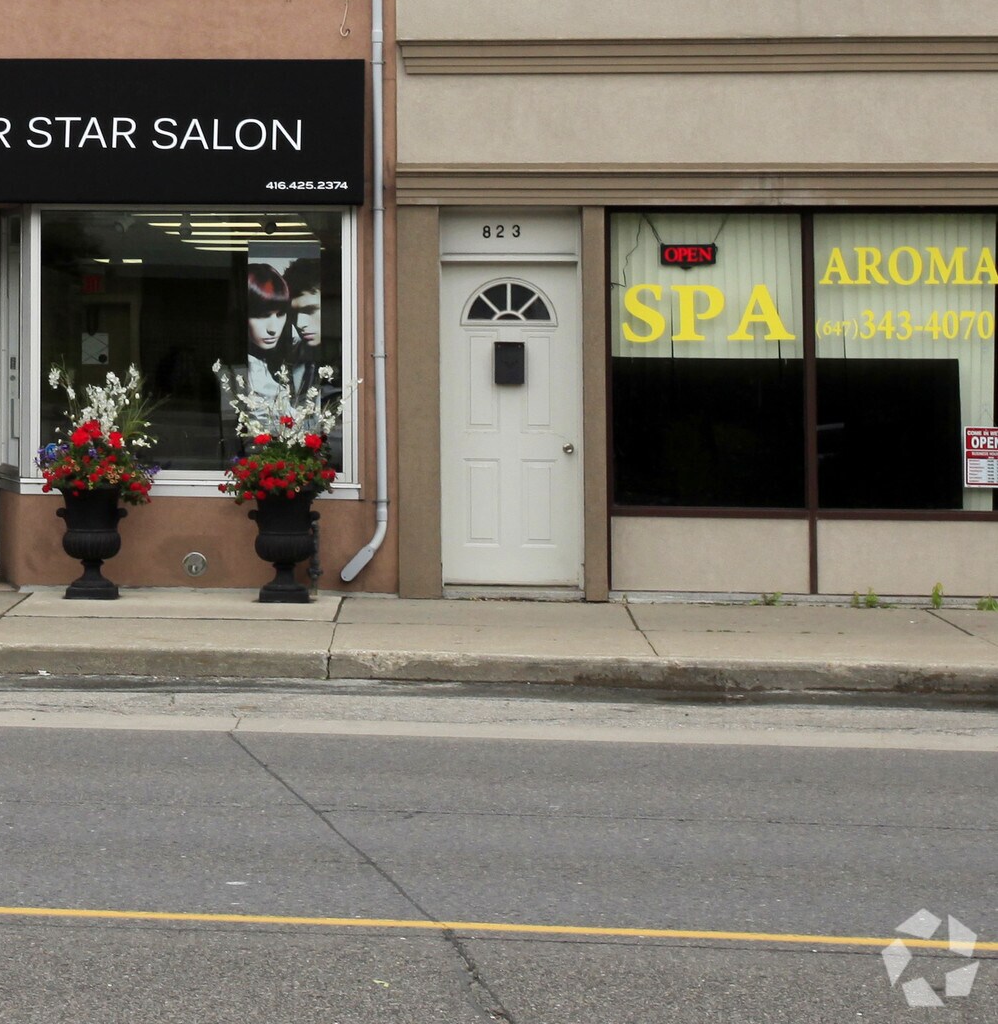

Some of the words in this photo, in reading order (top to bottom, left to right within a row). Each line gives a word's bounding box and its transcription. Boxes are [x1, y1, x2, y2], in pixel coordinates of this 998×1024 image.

[26, 117, 138, 149] STAR
[151, 118, 303, 151] SALON
[265, 181, 348, 190] 416.425.2374
[482, 224, 521, 239] 823
[664, 247, 713, 263] OPEN
[819, 246, 998, 286] AROMA
[622, 283, 796, 343] SPA
